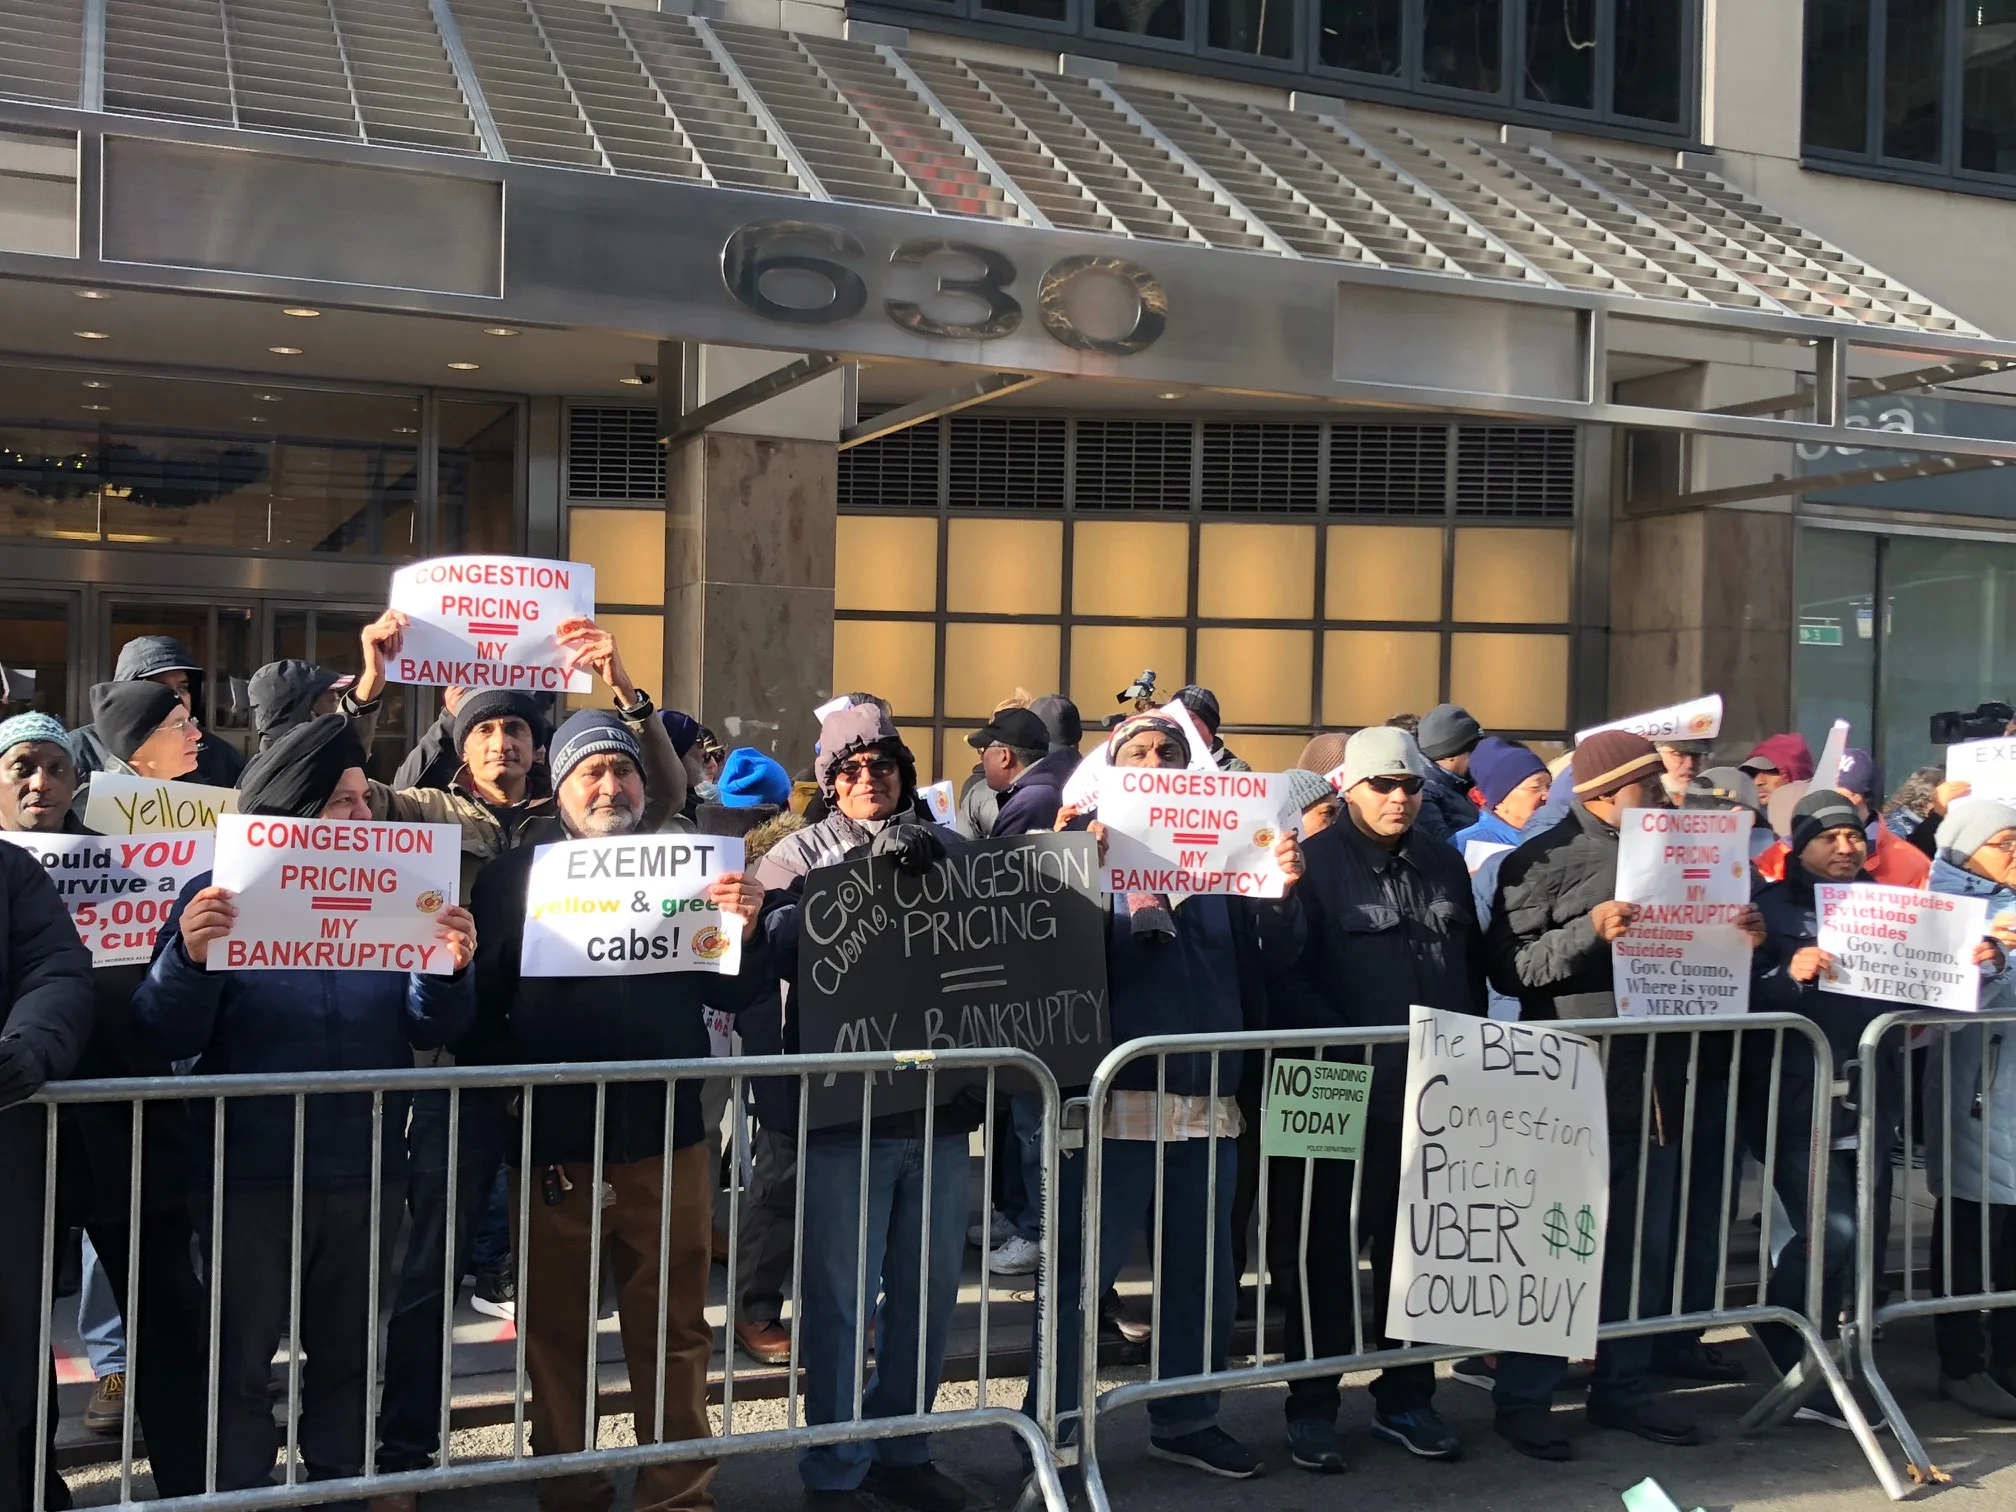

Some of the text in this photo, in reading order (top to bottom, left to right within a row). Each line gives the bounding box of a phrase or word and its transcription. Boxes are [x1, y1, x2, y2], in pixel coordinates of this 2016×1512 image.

[722, 219, 1168, 354] 630
[415, 564, 570, 590] CONGESTION
[441, 595, 539, 621] PRICING
[477, 641, 508, 661] MY
[401, 658, 575, 689] BANKRUPTCY
[1122, 772, 1267, 798] CONGESTION
[1149, 807, 1239, 830] PRICING
[1641, 813, 1738, 833] CONGESTION
[247, 821, 433, 854] CONGESTION
[120, 840, 196, 869] YOU
[566, 845, 715, 879] EXEMPT
[1179, 850, 1208, 868] MY
[1663, 845, 1720, 864] PRICING
[158, 876, 175, 892] a
[280, 865, 398, 893] PRICING
[893, 844, 1090, 909] CONGESTION
[1111, 868, 1268, 894] BANKRUPTCY
[531, 890, 719, 920] yellow & gree
[804, 857, 883, 945] GOV.
[1686, 885, 1706, 901] MY
[1821, 886, 1956, 912] Bankruptcies
[1822, 903, 1918, 925] Evictions
[320, 918, 358, 939] MY
[904, 899, 1057, 958] PRICING
[1823, 919, 1908, 941] Suicides
[227, 940, 436, 970] BANKRUPTCY
[587, 926, 680, 962] cabs!
[1616, 941, 1684, 959] Suicides
[1847, 935, 1887, 955] Gov.
[1630, 958, 1733, 980] Gov. Cuomo,
[1839, 953, 1965, 984] Where is your
[1625, 977, 1738, 999] Where is your
[1860, 976, 1942, 1002] MERCY?
[1646, 998, 1719, 1016] MERCY?
[823, 988, 1105, 1087] MY BANKRUPTCY
[1417, 1017, 1589, 1090] The BEST
[1274, 1065, 1368, 1097] NO STANDING
[1311, 1086, 1364, 1103] STOPPING
[1280, 1109, 1351, 1136] TODAY
[1415, 1074, 1595, 1157] Congestion
[1323, 1145, 1356, 1154] DEPARTMENT
[1420, 1142, 1537, 1209] Pricing
[1409, 1201, 1597, 1267] UBER $$
[1404, 1273, 1587, 1337] COULD BUY
